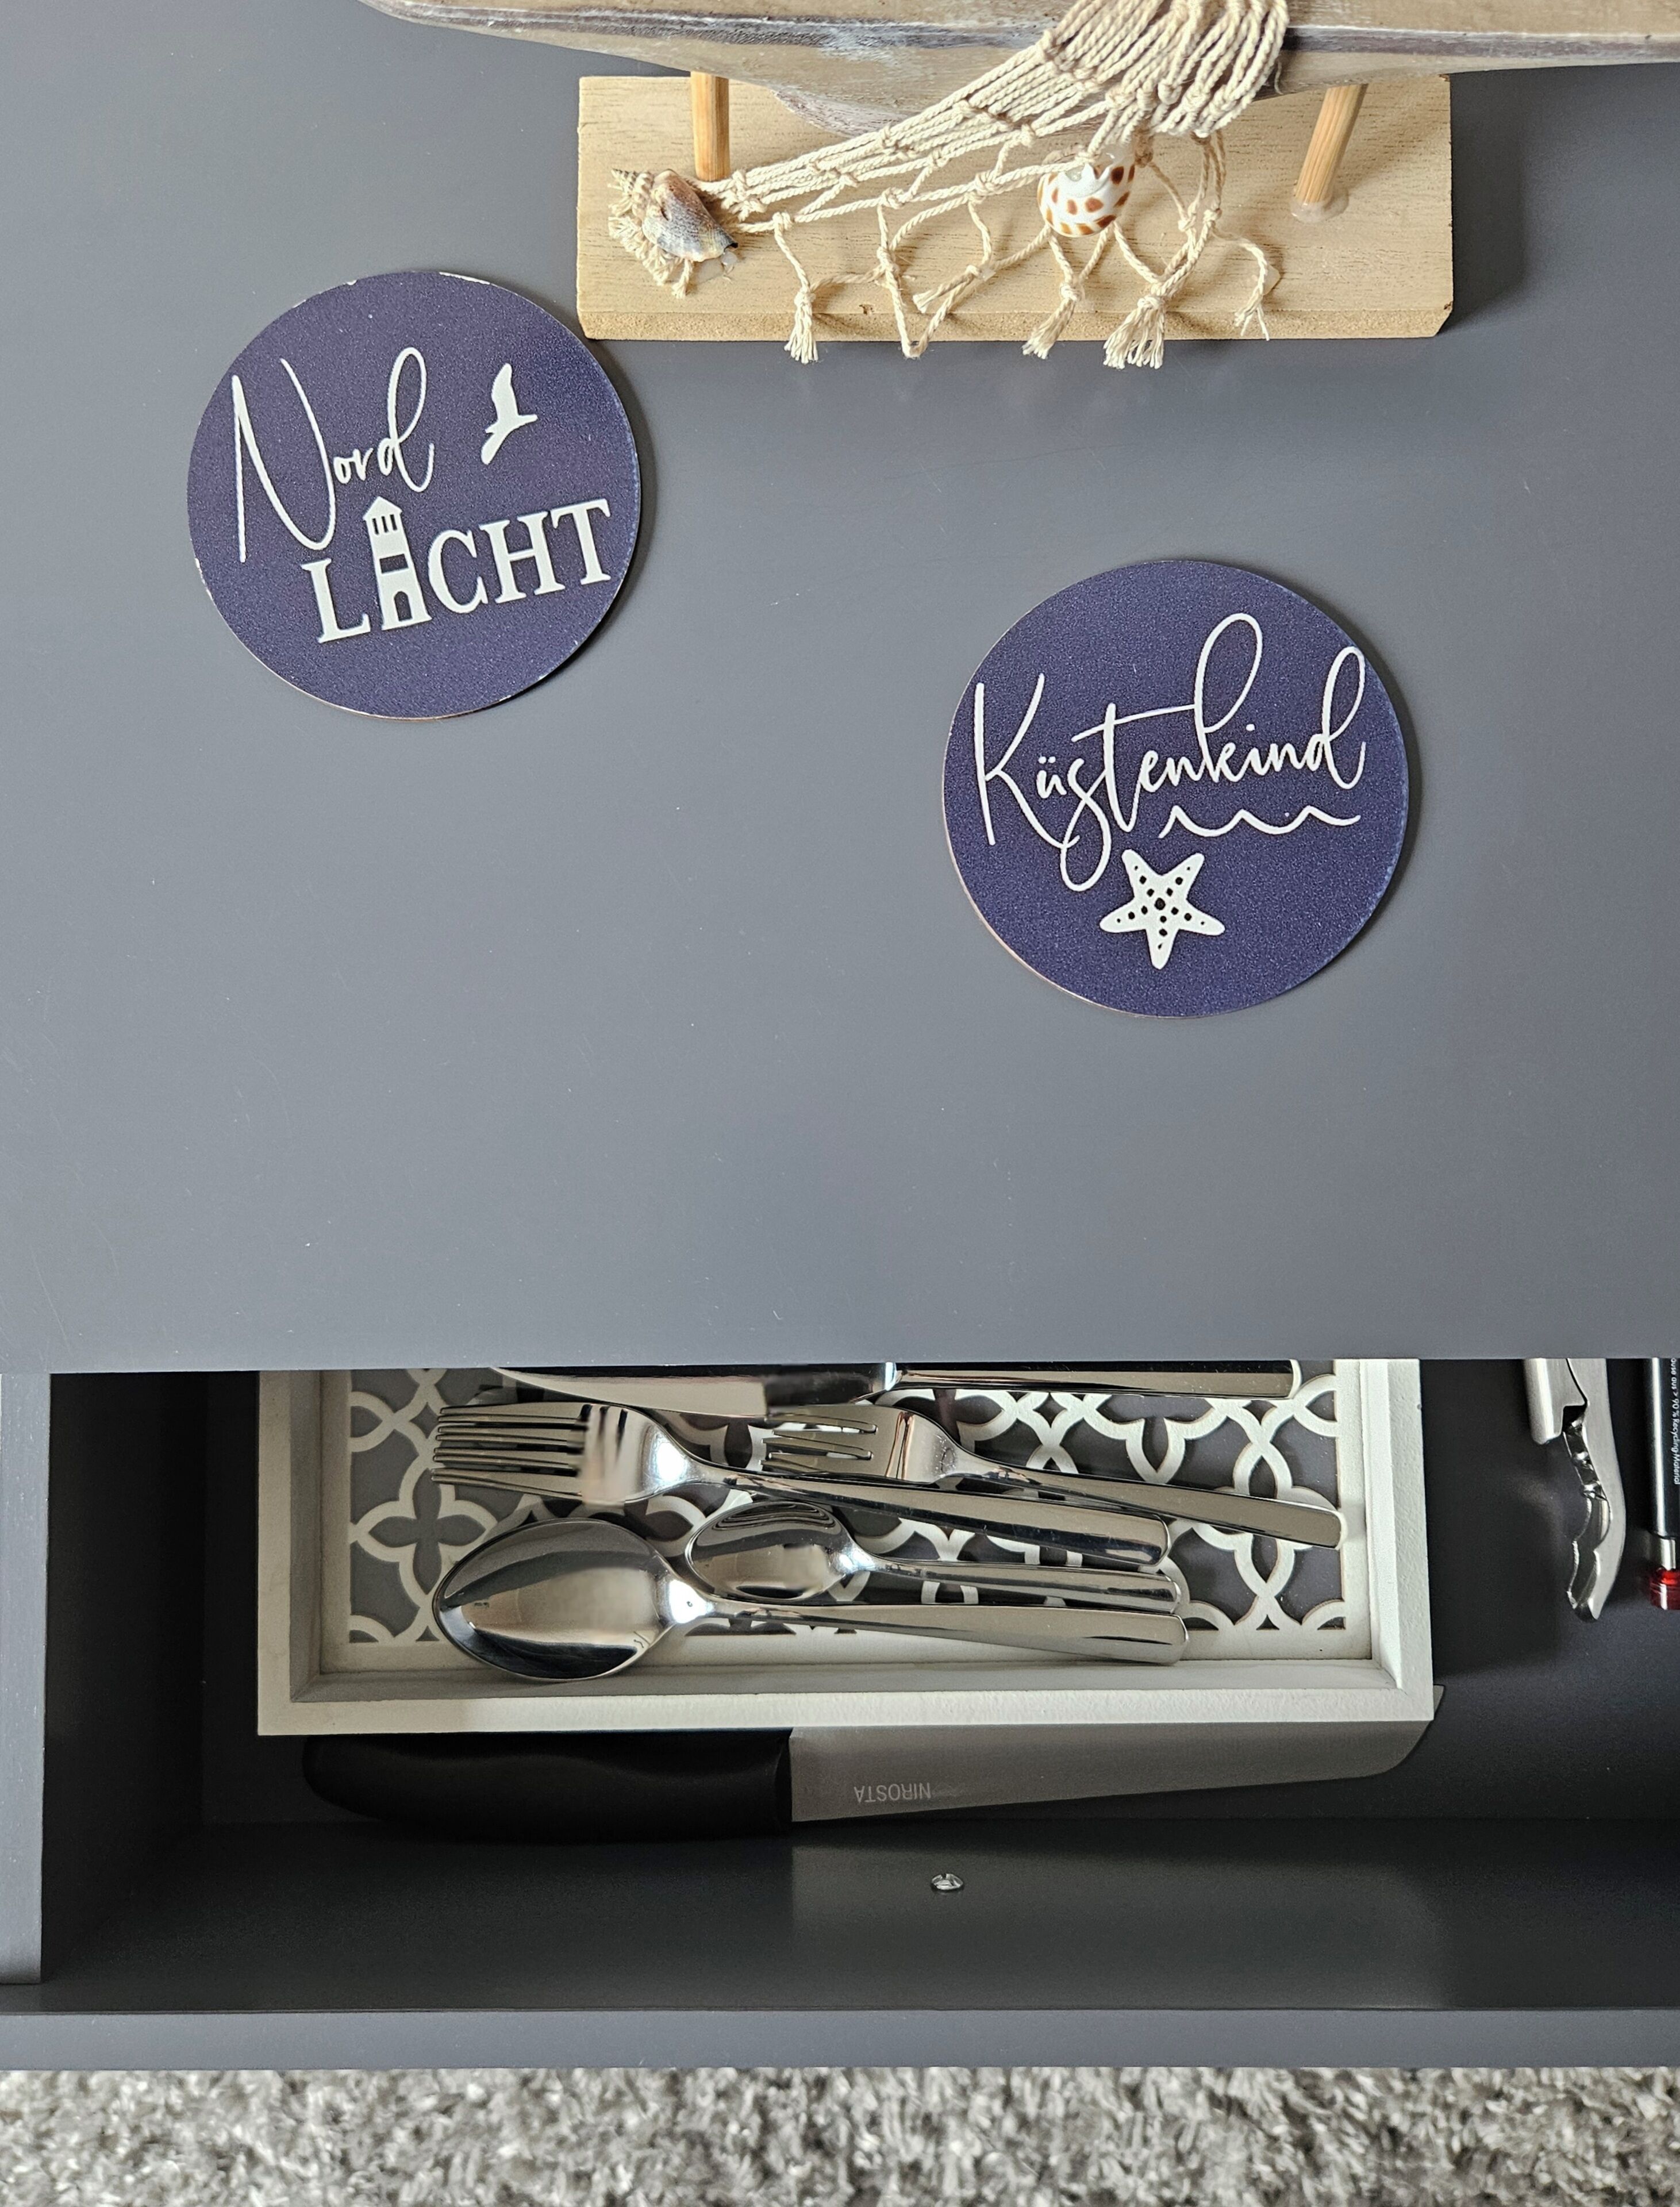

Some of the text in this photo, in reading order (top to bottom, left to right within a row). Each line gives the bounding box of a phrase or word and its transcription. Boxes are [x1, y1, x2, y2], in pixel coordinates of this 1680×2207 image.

[232, 347, 435, 563] Nord
[974, 612, 1367, 891] Küstenkind
[1671, 1398, 1679, 1409] 90
[854, 1782, 932, 1804] NIROSTA
